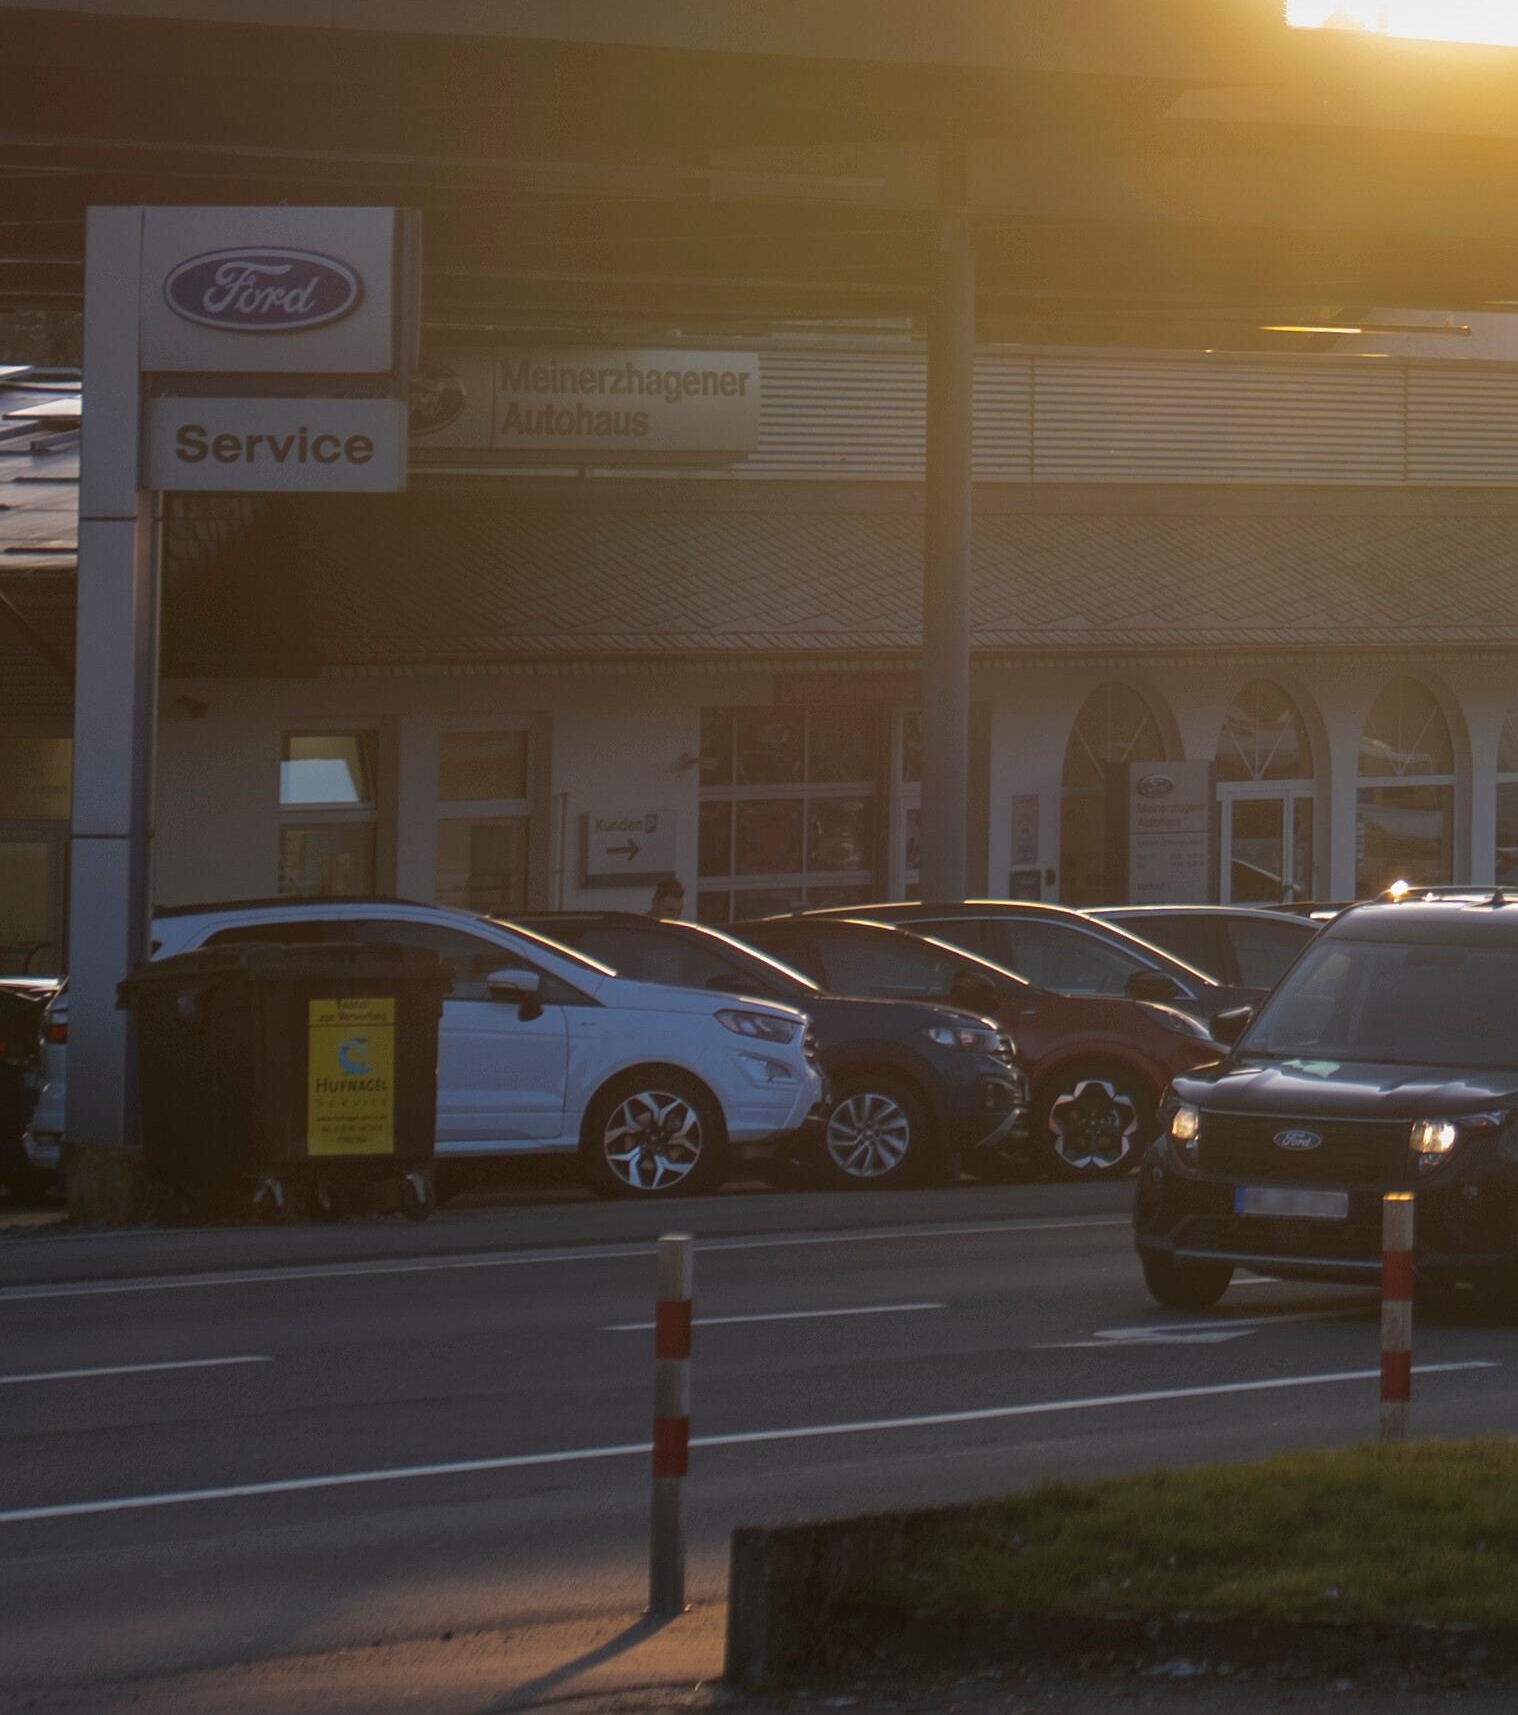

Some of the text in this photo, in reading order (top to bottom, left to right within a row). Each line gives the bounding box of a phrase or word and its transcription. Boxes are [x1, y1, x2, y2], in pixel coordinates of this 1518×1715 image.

[202, 261, 320, 317] Ford
[500, 359, 751, 404] Meinerzhagener
[500, 402, 650, 438] Autohaus
[174, 424, 375, 465] Service
[595, 819, 643, 832] Kunden
[315, 1076, 388, 1094] HUFNAGEL
[1282, 1132, 1313, 1147] Ford
